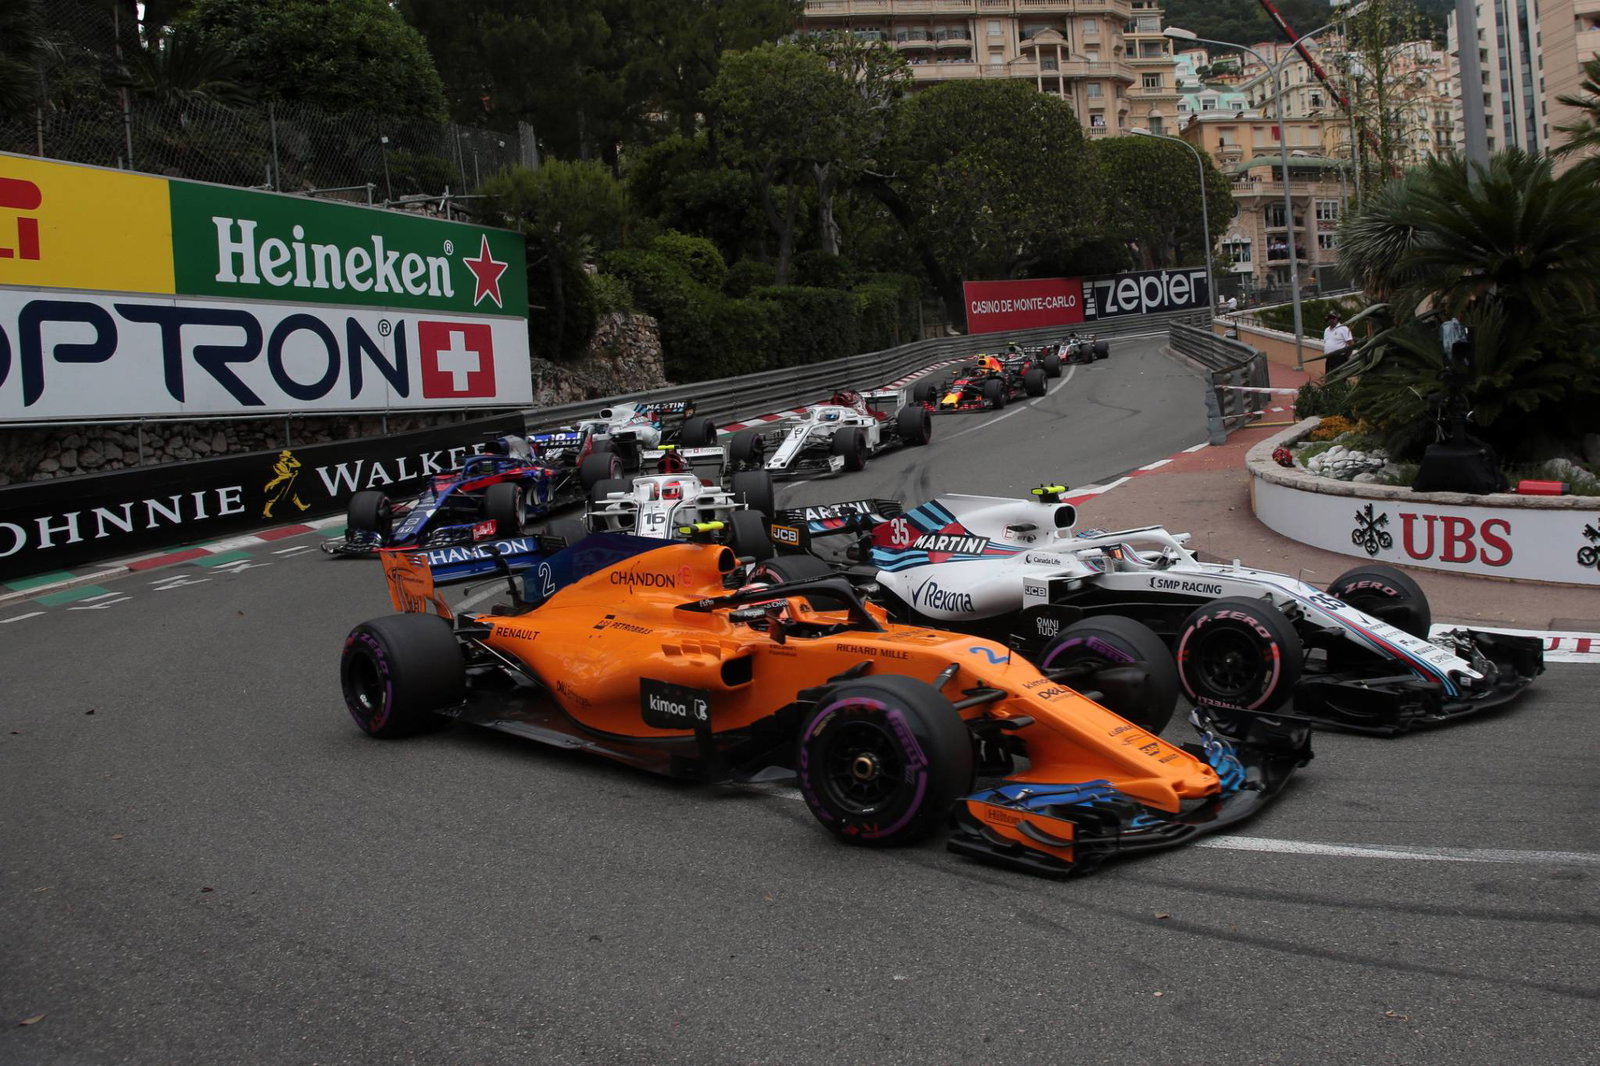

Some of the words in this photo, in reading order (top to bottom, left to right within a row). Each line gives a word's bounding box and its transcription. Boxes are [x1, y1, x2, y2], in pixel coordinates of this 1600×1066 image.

[211, 215, 454, 298] Heineken
[1095, 270, 1207, 314] zepter
[971, 300, 1000, 314] CASINO
[1001, 299, 1013, 312] DE
[1013, 295, 1076, 311] MONTE-CARLO
[0, 299, 410, 407] PTRON
[643, 512, 666, 524] 16
[773, 528, 797, 542] JCB
[890, 518, 910, 545] 35
[1399, 512, 1513, 567] UBS
[912, 534, 988, 554] MARTINI
[538, 561, 556, 598] 2
[610, 571, 676, 588] CHANDON
[1157, 578, 1179, 589] SMP
[1181, 580, 1222, 594] RACING
[1345, 580, 1398, 597] ZERO
[924, 581, 975, 612] Rexona
[1026, 585, 1046, 596] JCB
[1308, 592, 1346, 611] 35
[1036, 616, 1059, 627] OMNI
[1214, 609, 1272, 639] ZERO
[496, 626, 541, 641] RENAULT
[836, 643, 877, 656] RICHARD
[880, 649, 908, 660] MILLE
[968, 646, 1011, 664] 2
[649, 694, 687, 716] kimoa
